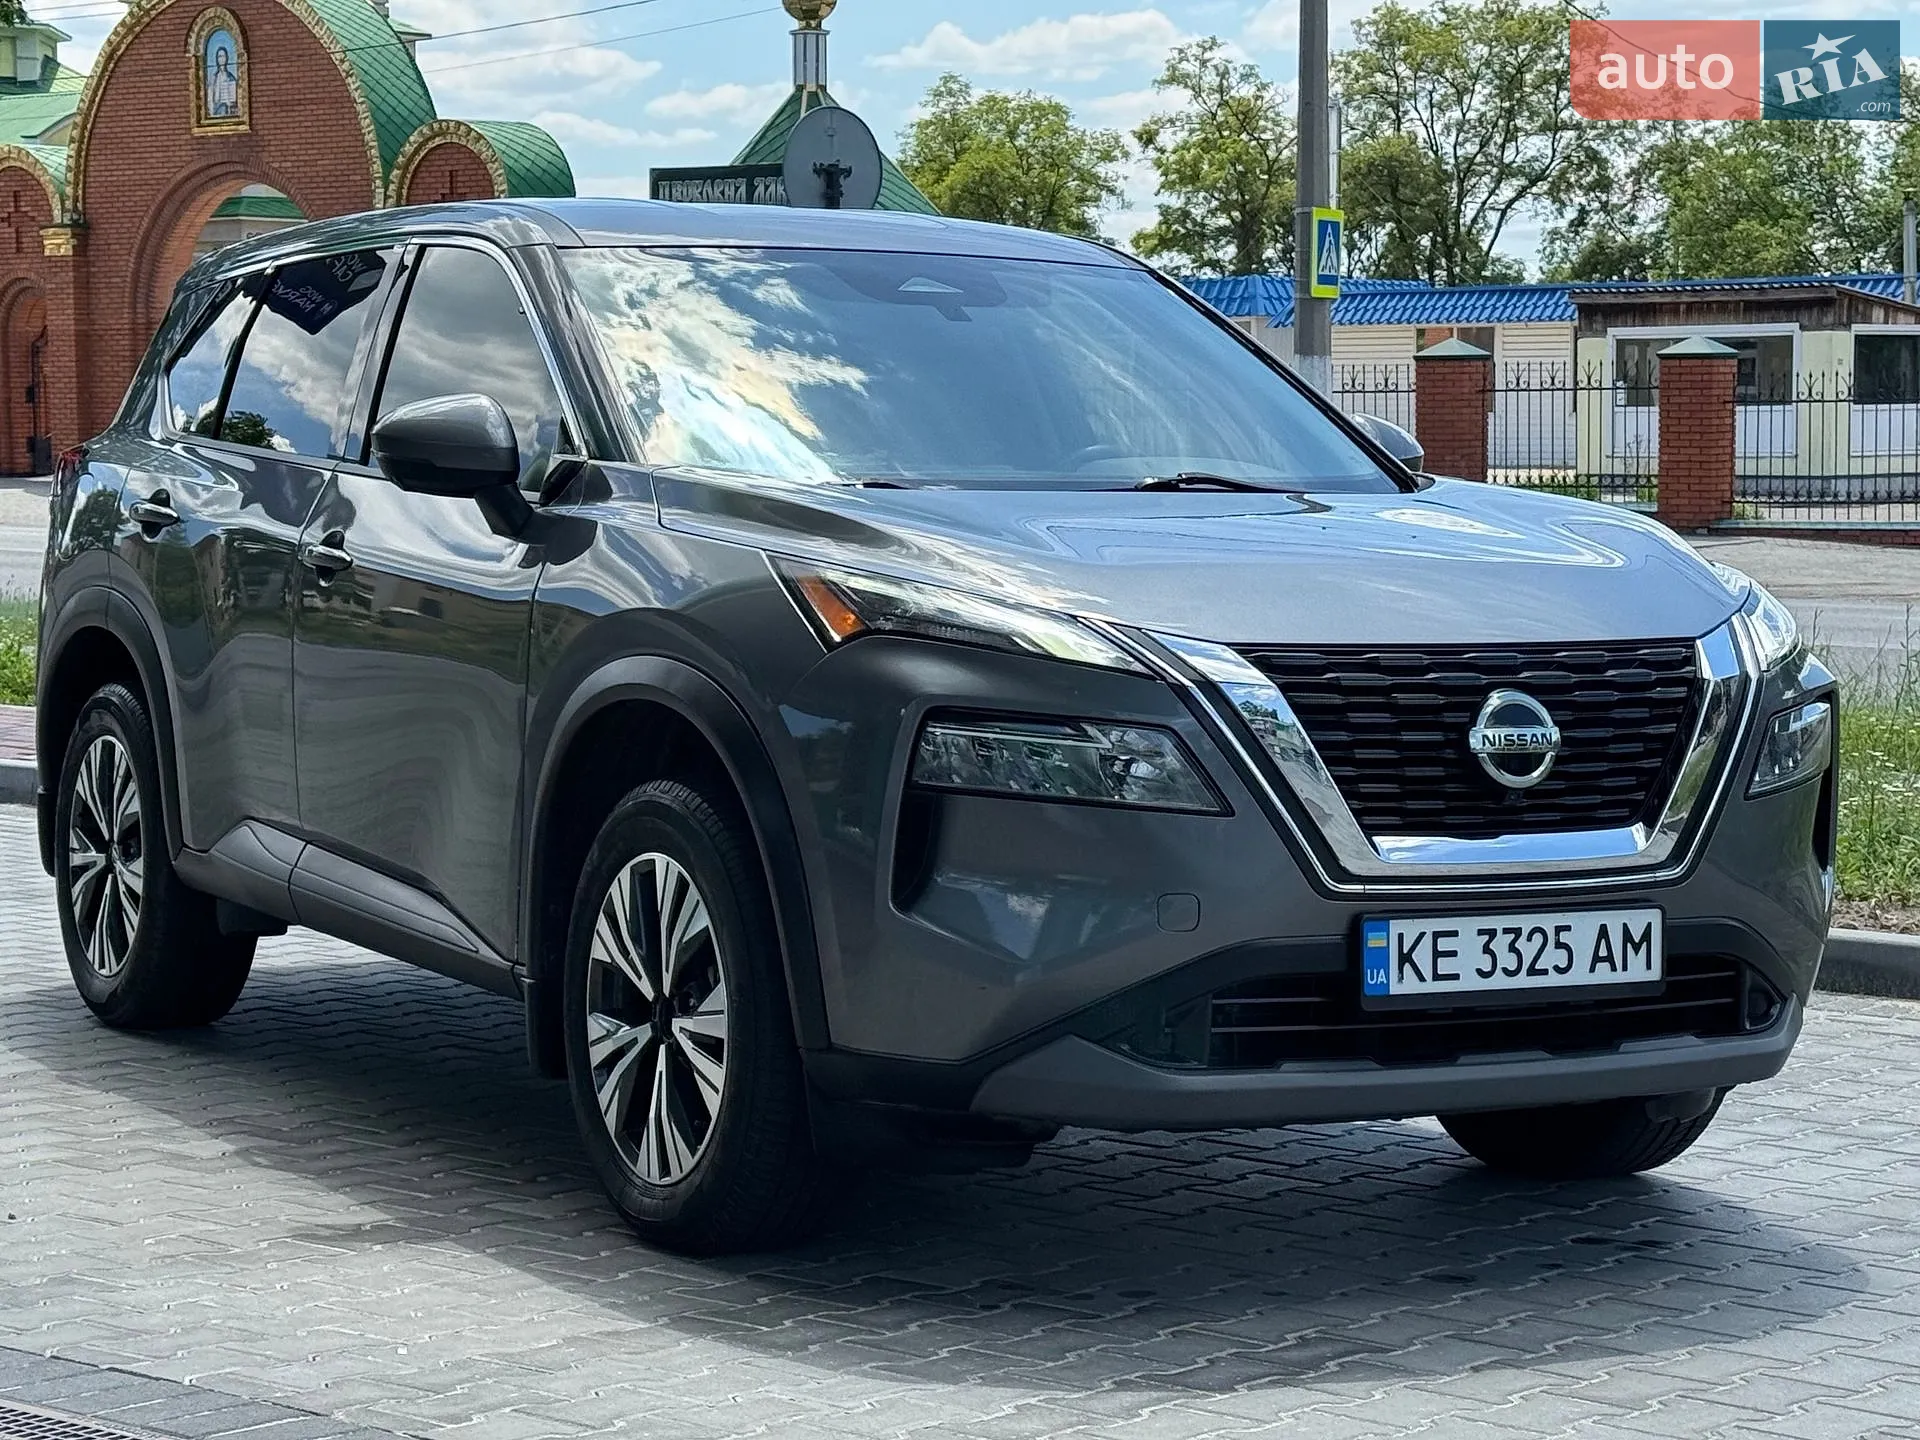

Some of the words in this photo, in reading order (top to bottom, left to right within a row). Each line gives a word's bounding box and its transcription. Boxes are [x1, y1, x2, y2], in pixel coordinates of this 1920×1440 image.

[1481, 733, 1552, 747] NISSAN
[1397, 929, 1460, 984] KE
[1475, 925, 1574, 979] 3325
[1588, 921, 1652, 973] AM
[1367, 968, 1387, 984] UA
